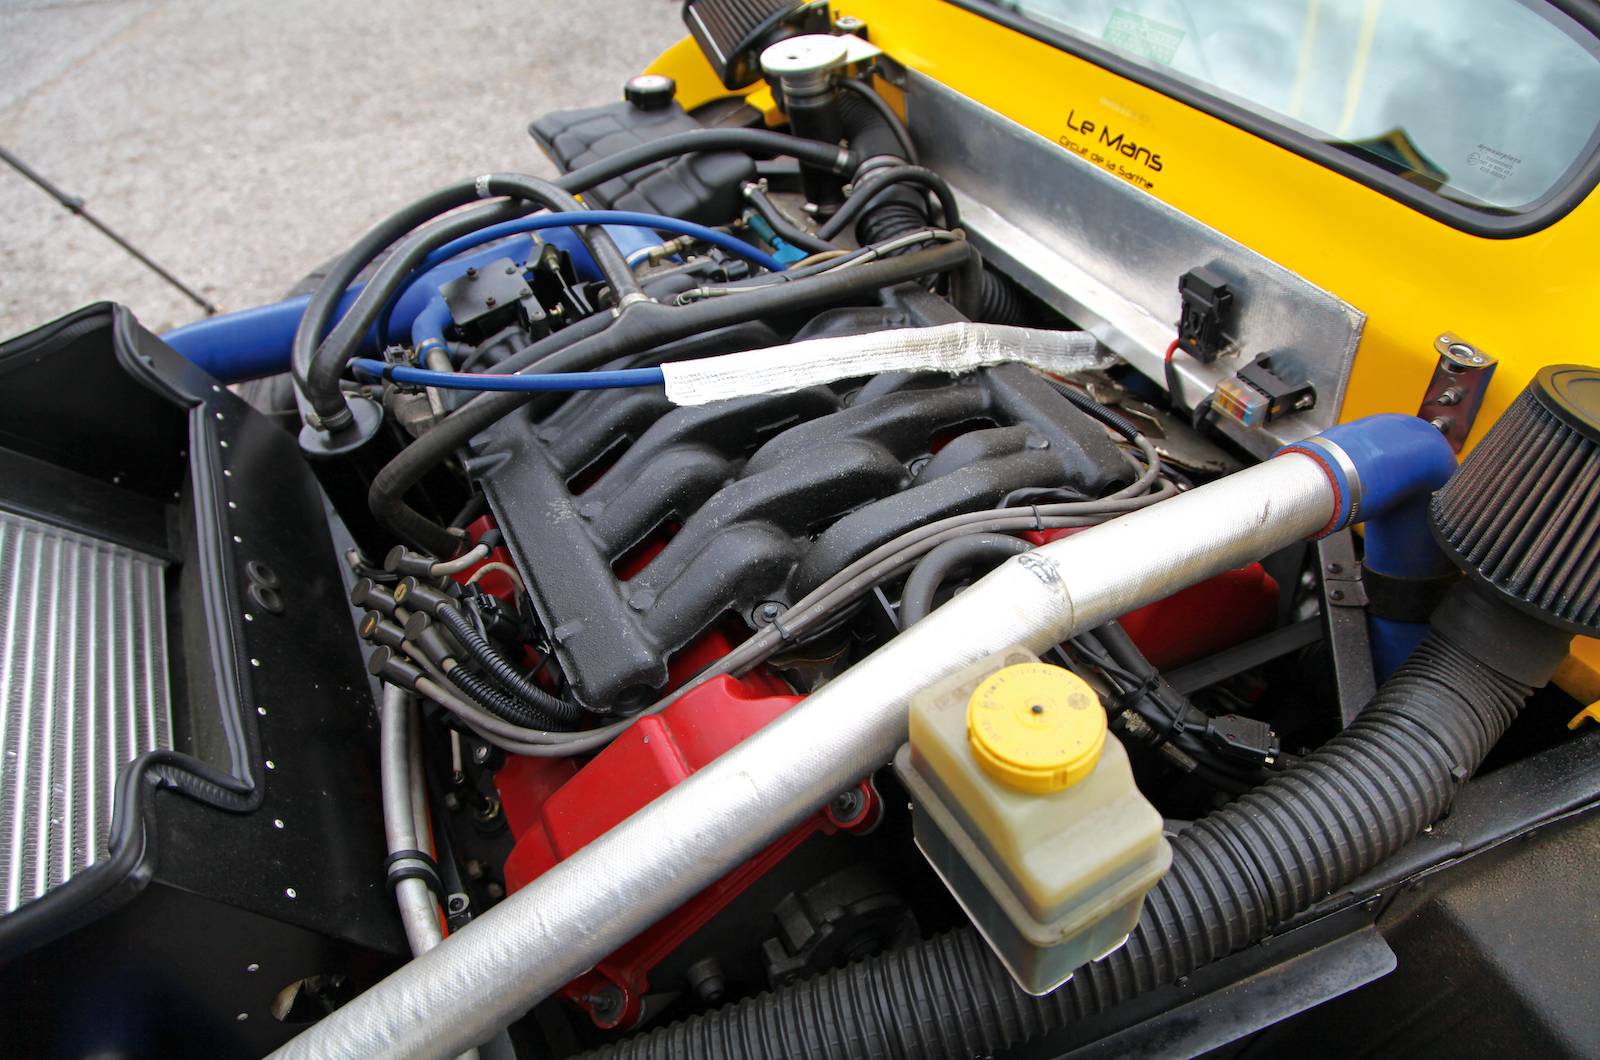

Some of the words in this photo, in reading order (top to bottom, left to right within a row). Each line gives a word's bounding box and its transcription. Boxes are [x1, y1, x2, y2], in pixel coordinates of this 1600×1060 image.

[1146, 29, 1179, 46] VALLEY
[1059, 135, 1089, 156] Circuit
[1090, 152, 1104, 163] de
[1106, 159, 1116, 171] la
[1118, 165, 1154, 189] Sarthe
[1067, 109, 1095, 135] Le
[1099, 125, 1163, 172] Mans
